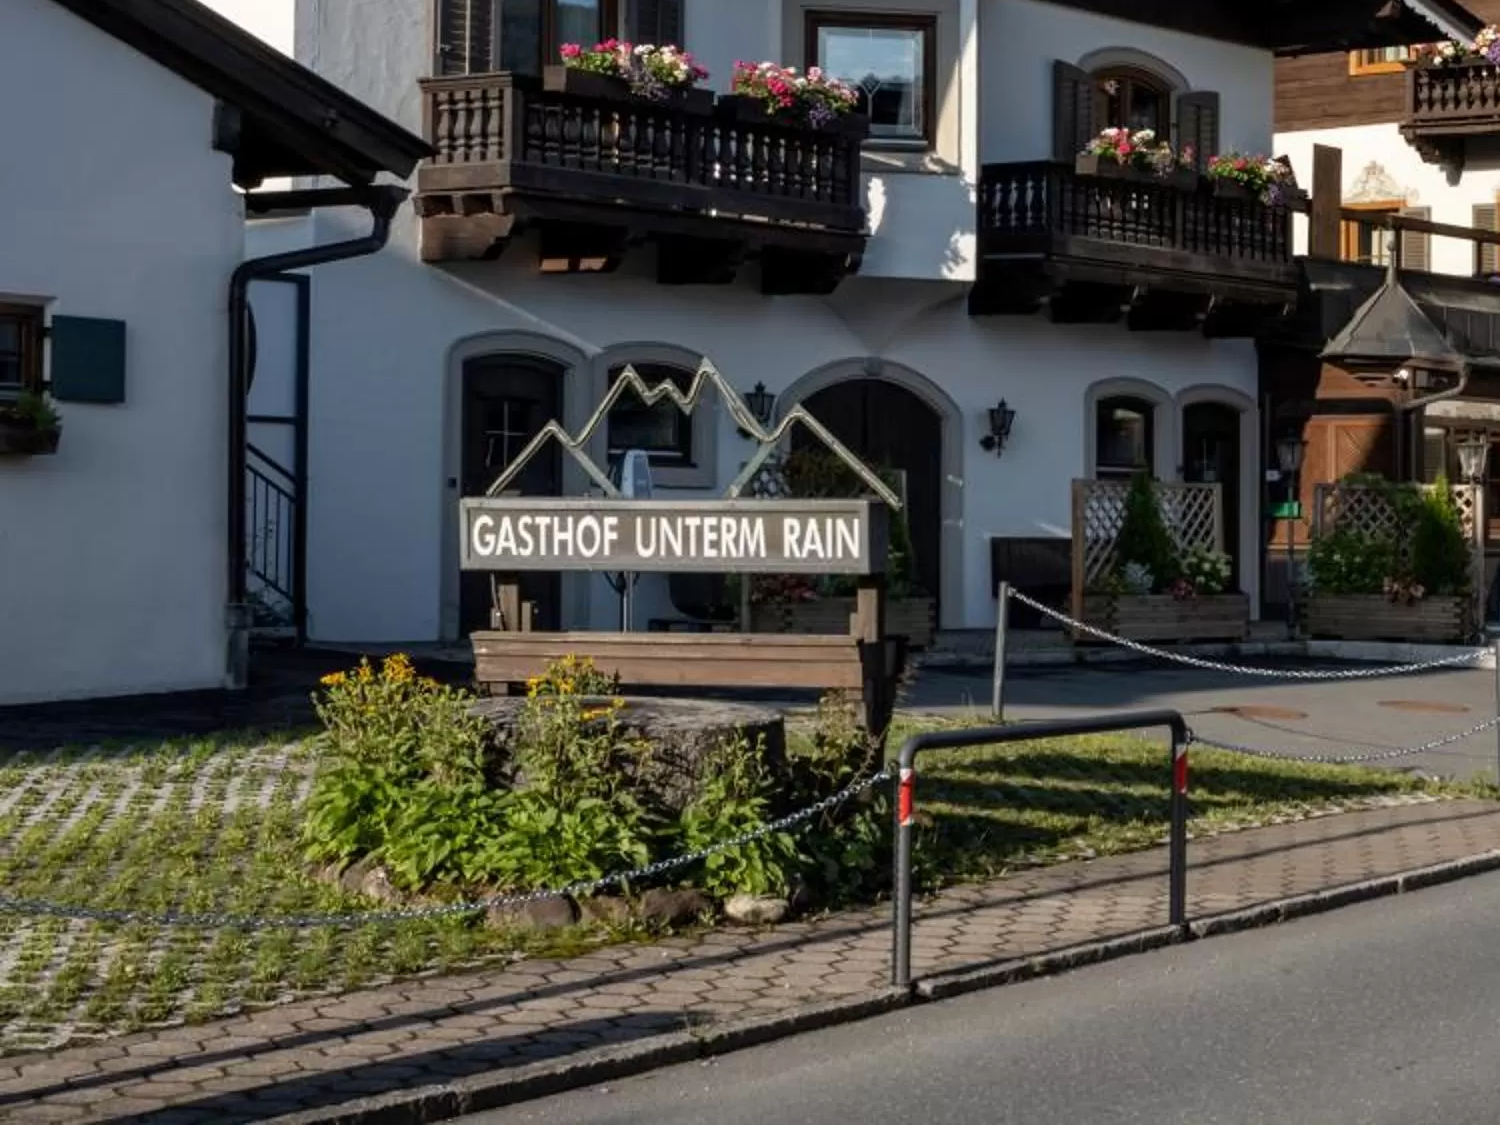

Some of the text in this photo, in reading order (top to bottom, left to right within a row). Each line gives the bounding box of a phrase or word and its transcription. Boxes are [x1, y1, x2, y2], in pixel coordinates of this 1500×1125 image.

[472, 515, 861, 559] GASTHOF UNTERM RAIN
